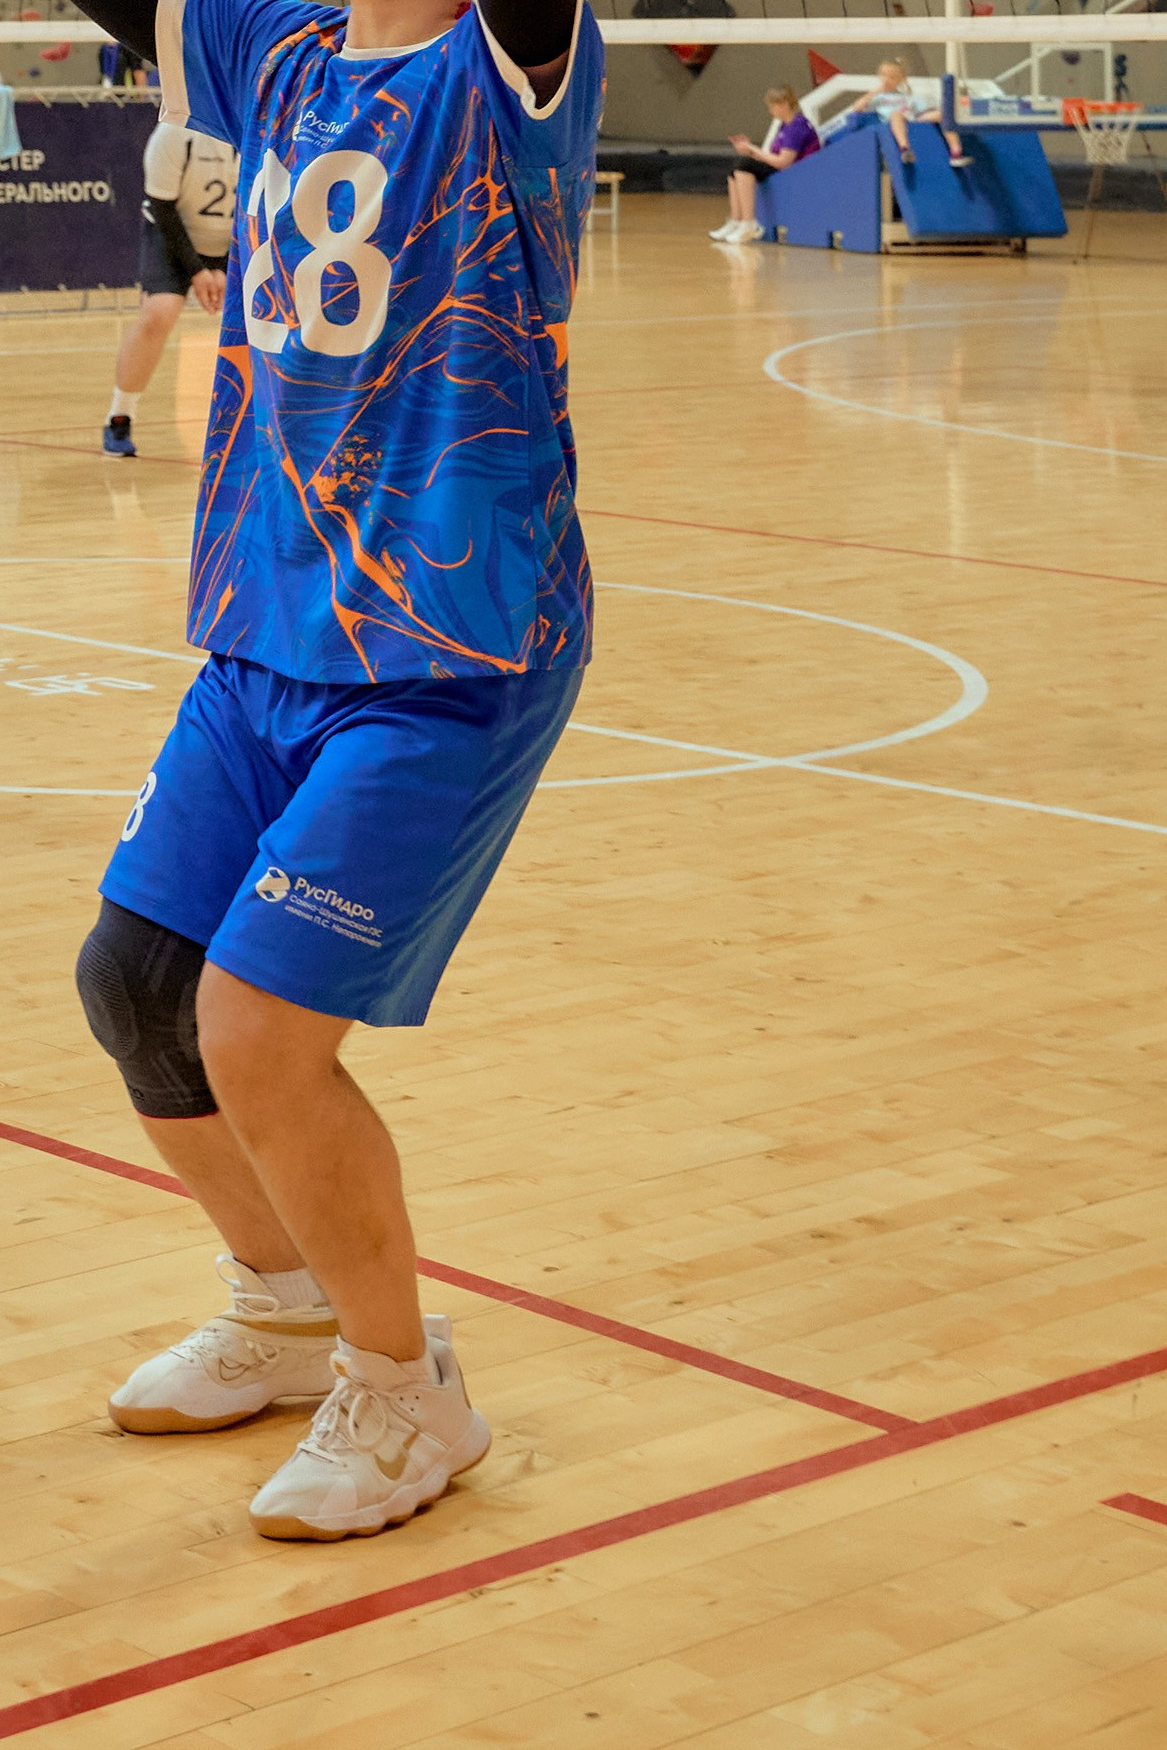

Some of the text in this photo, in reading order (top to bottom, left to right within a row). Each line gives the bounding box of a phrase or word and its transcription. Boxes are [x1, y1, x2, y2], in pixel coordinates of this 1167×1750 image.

[199, 180, 236, 217] 2
[243, 149, 392, 356] 28
[294, 876, 374, 921] РусГидро
